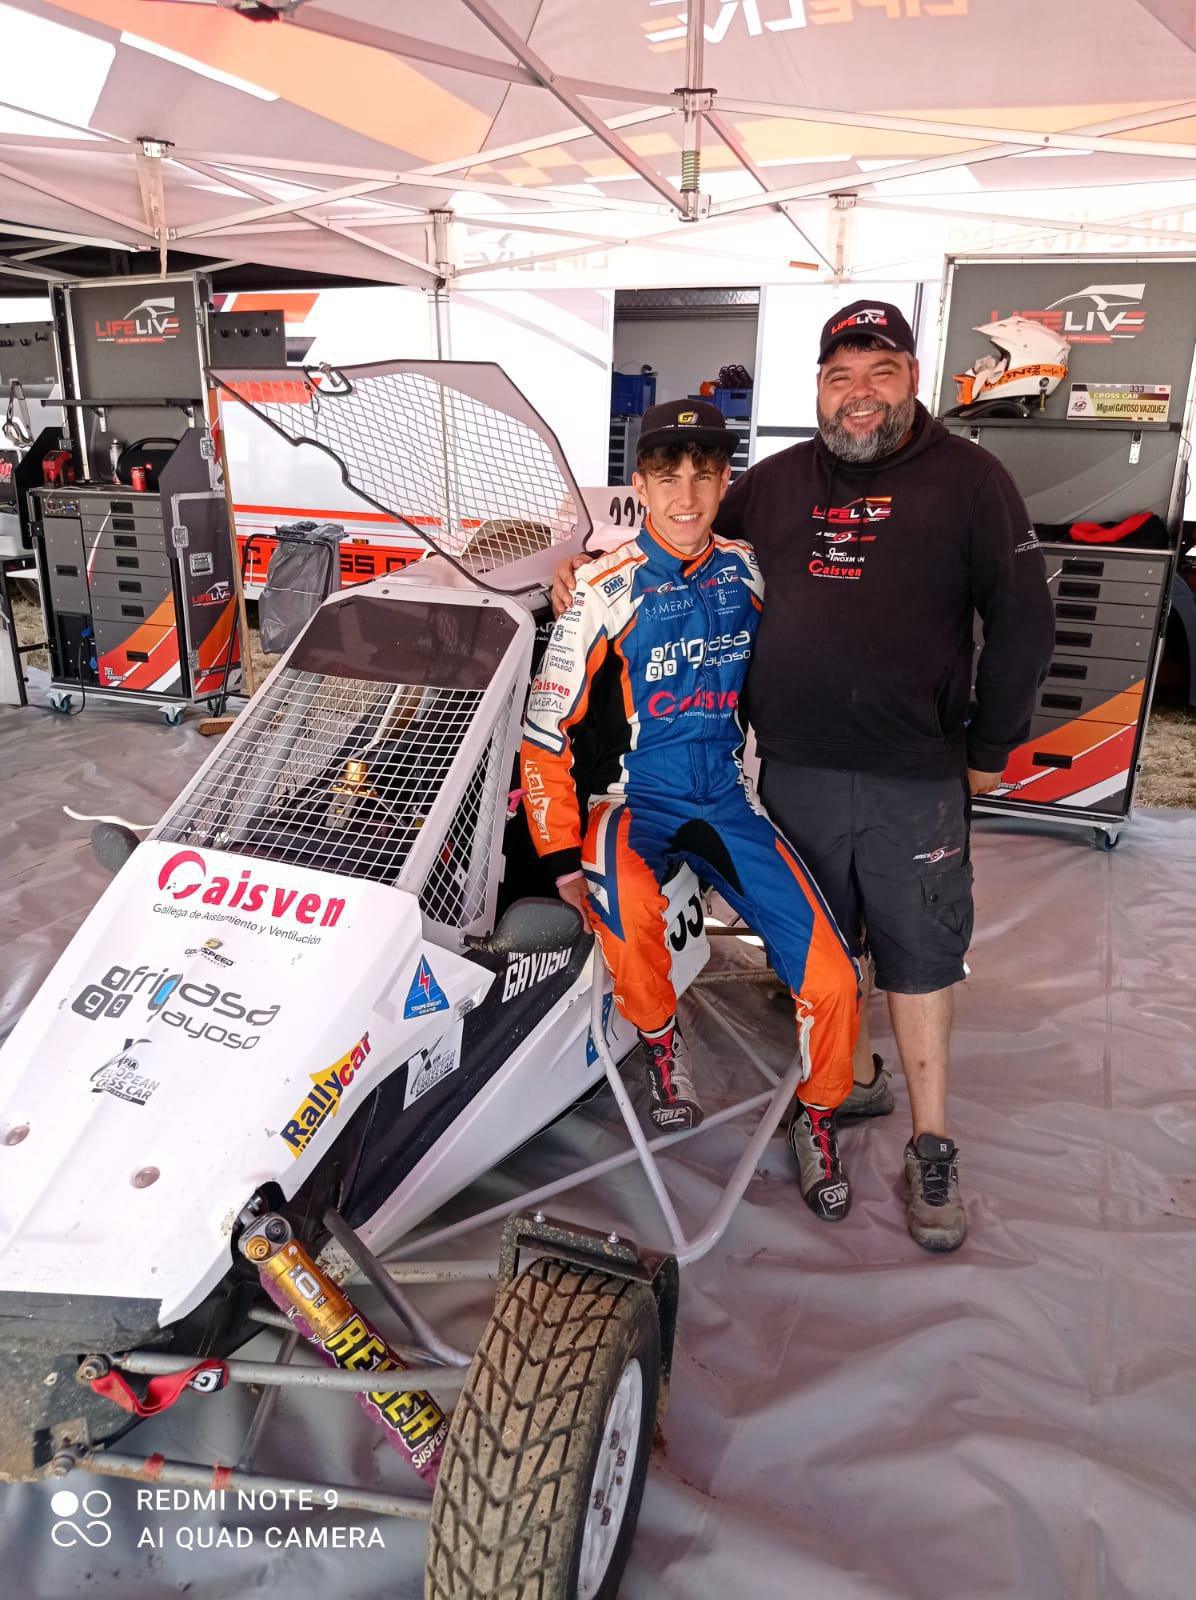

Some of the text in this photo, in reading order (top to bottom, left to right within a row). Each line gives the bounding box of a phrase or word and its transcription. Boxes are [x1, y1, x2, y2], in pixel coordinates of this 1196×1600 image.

[95, 317, 181, 337] LIFELIVE
[831, 315, 888, 335] LIFELIVE
[1121, 392, 1139, 400] CAR
[1129, 385, 1145, 393] 333
[1096, 403, 1166, 414] Miguel GAYOSO VAZQUEZ
[603, 577, 625, 595] OMP
[549, 662, 573, 673] GALEGO
[158, 851, 346, 927] Caisven
[153, 903, 188, 919] Gallega
[189, 910, 201, 919] de
[201, 911, 258, 931] Aislamiento
[257, 926, 267, 936] y
[126, 1085, 152, 1100] CAR
[280, 1031, 371, 1148] Rallycar
